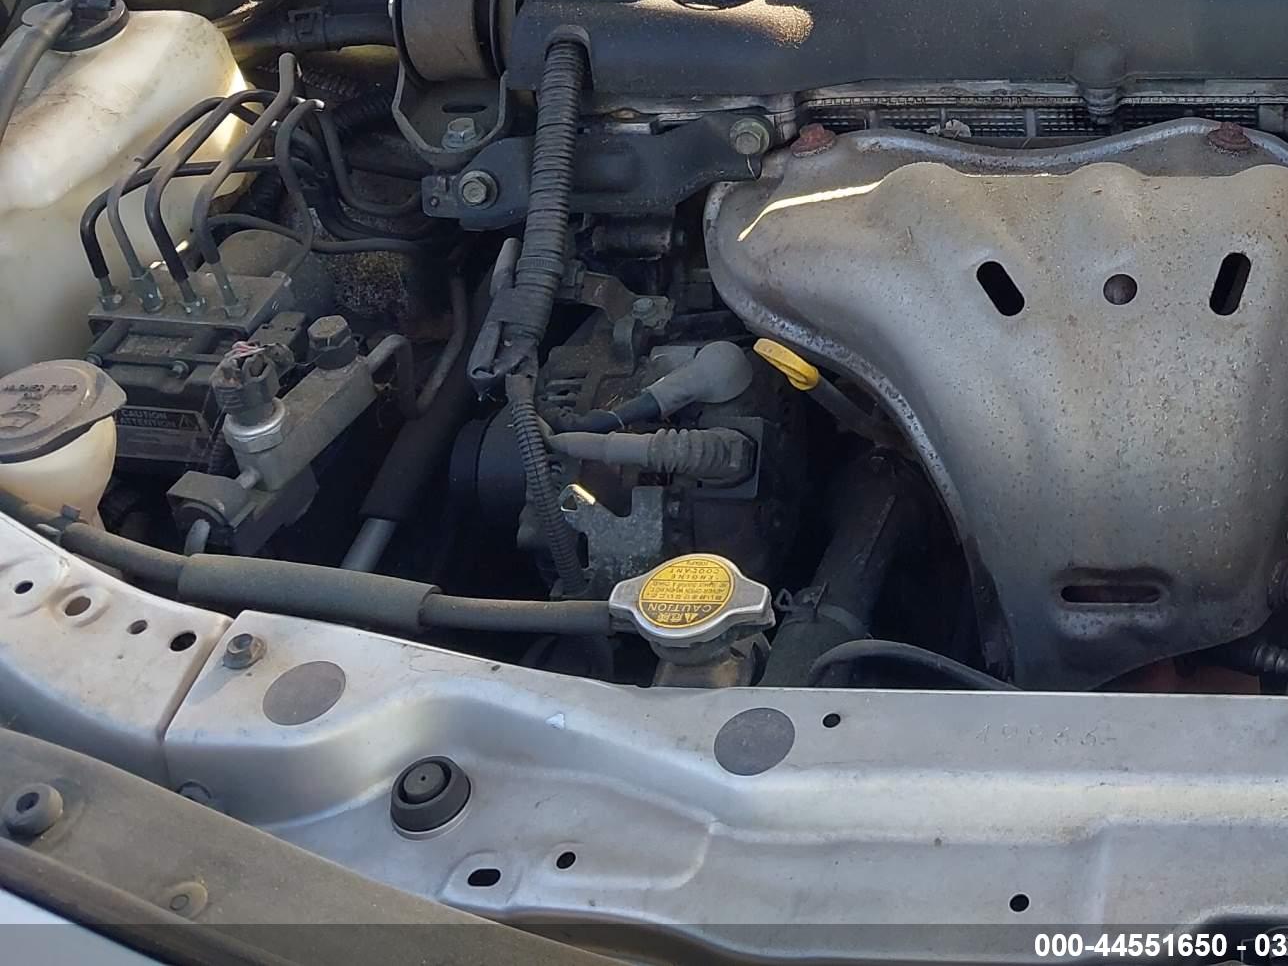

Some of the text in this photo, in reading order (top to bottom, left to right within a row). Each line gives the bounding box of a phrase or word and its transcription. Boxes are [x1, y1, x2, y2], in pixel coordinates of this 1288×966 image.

[121, 409, 167, 419] CAUTION
[120, 417, 176, 427] ATTENTION
[647, 603, 712, 613] CAUTION
